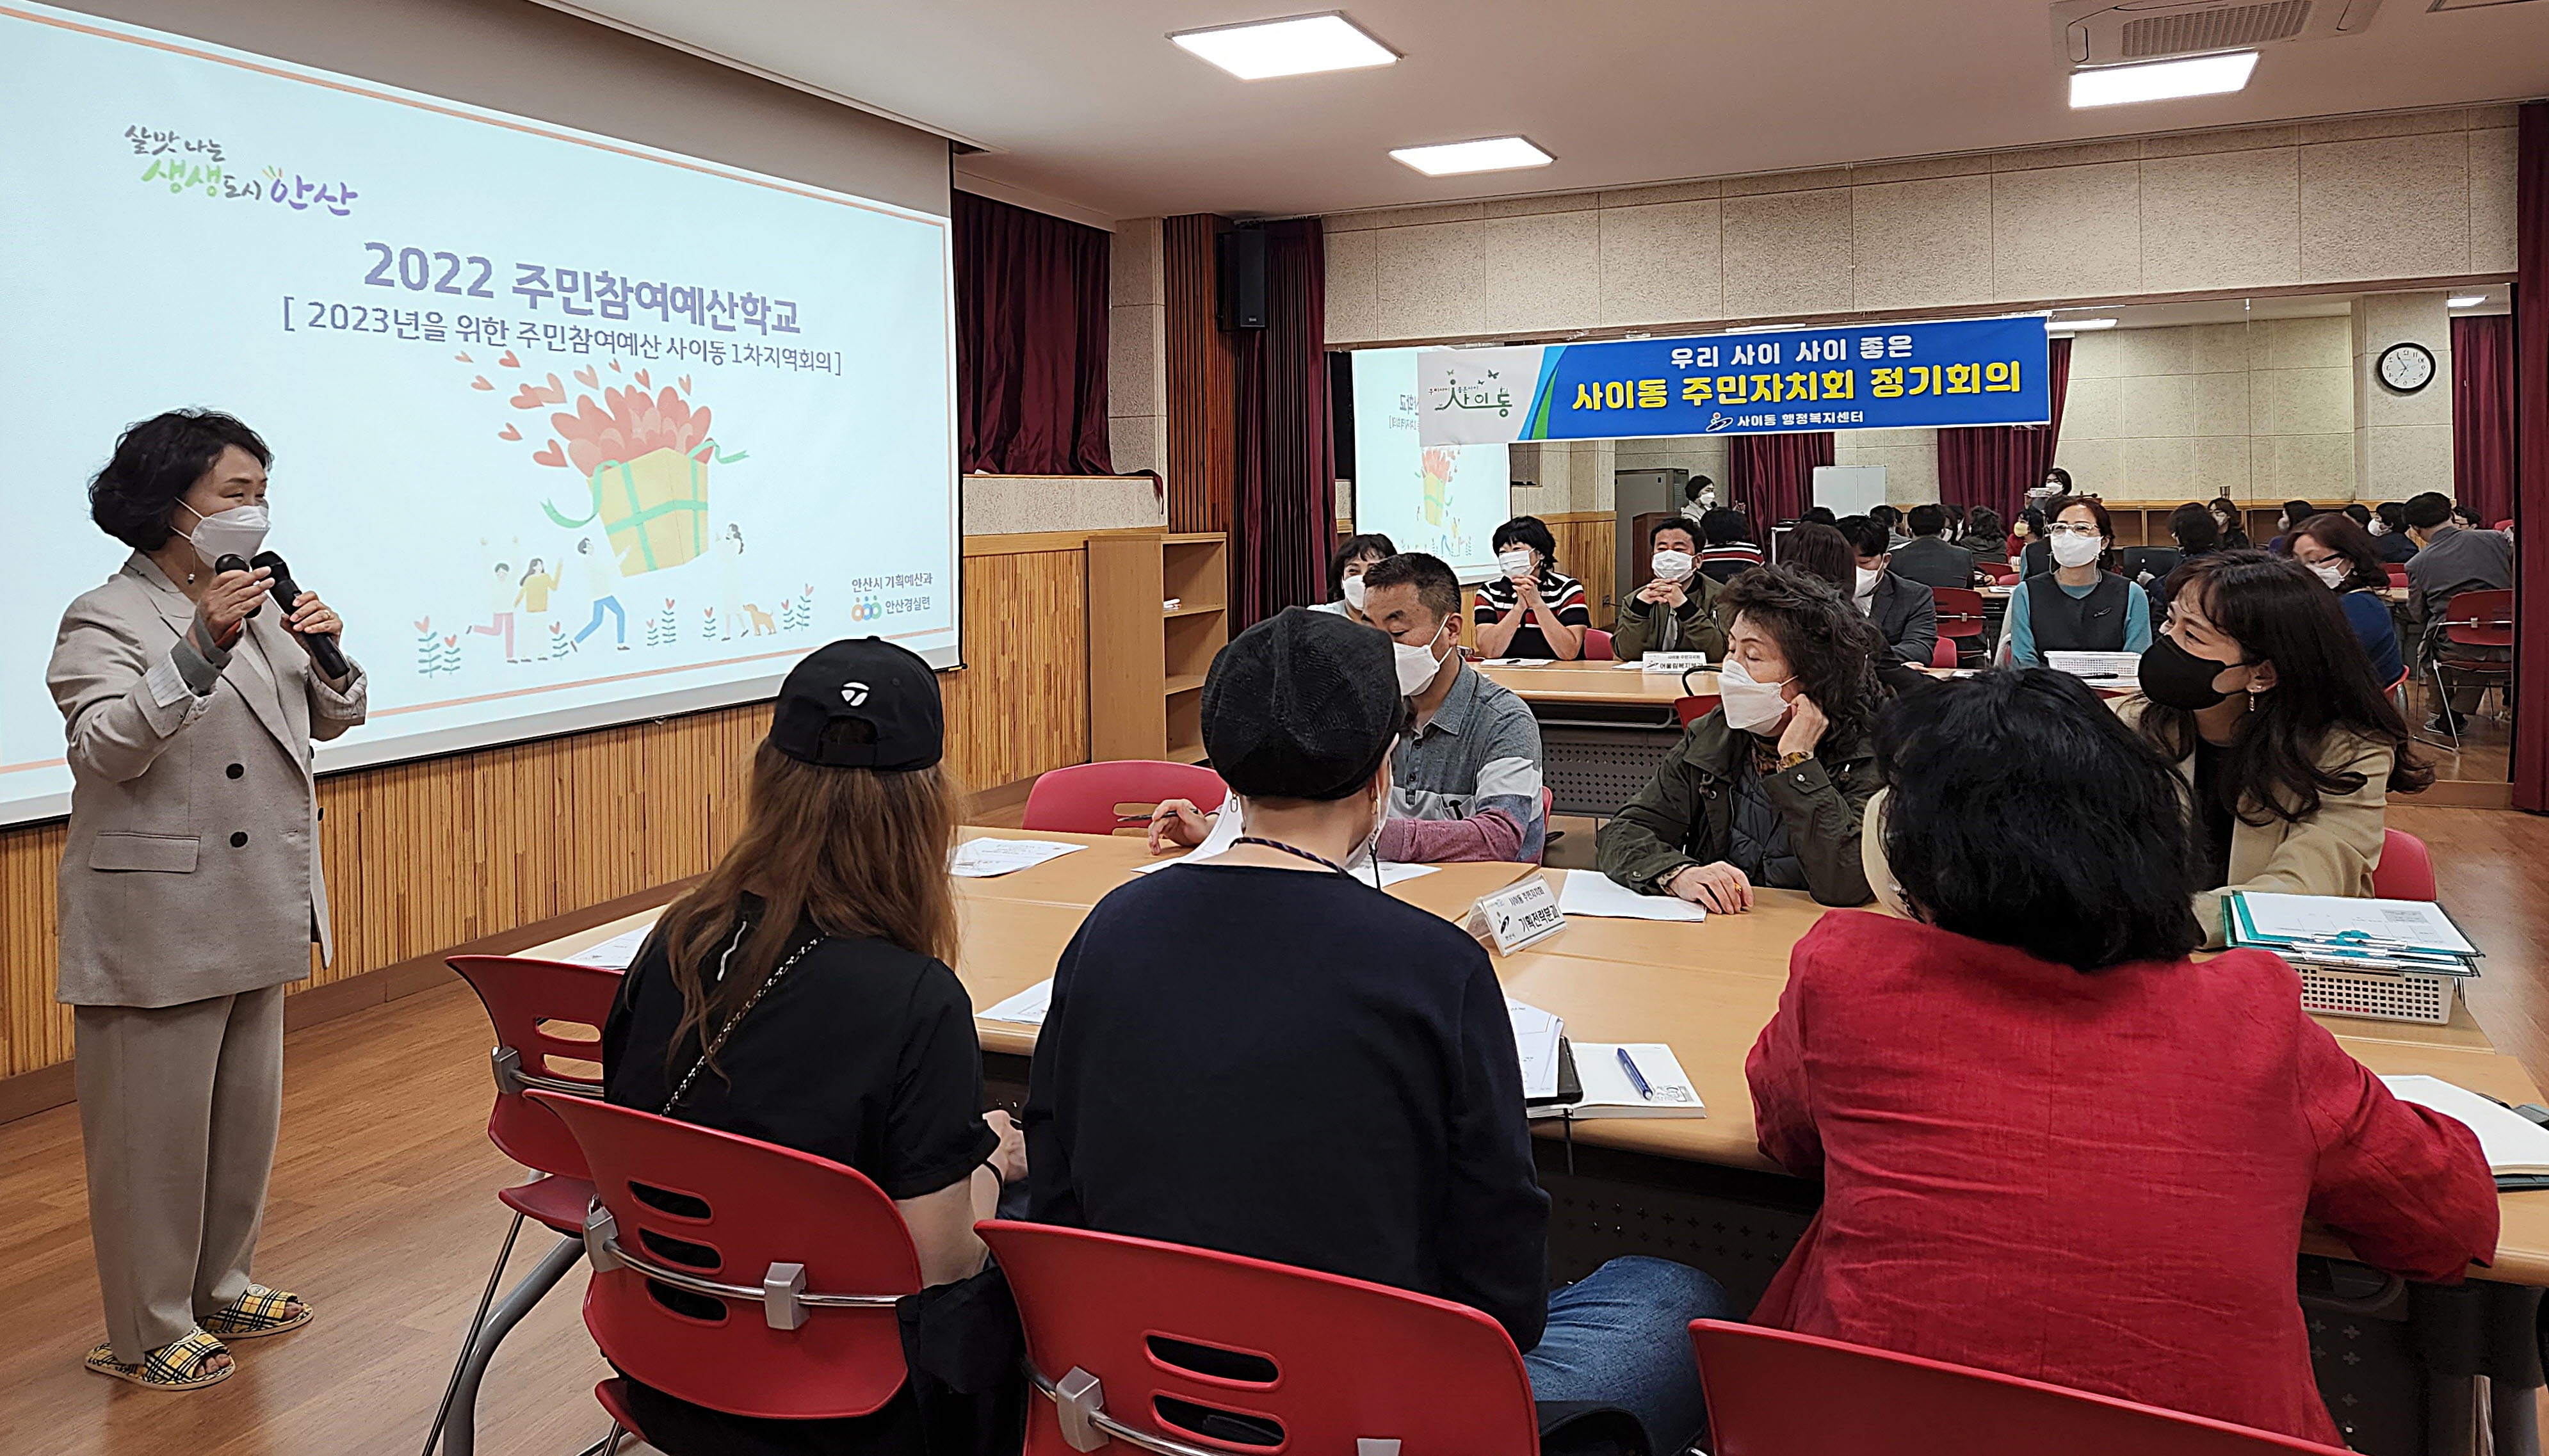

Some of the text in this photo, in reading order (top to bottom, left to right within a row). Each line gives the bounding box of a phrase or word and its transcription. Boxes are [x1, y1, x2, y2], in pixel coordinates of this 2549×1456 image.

[270, 174, 359, 216] 안산
[364, 241, 800, 336] 2022 주민참여예산학교
[307, 301, 448, 342] 2023년을
[455, 314, 510, 346] 위한
[516, 321, 661, 359] 주민참여예산
[666, 337, 727, 366] 사이동
[1671, 336, 1913, 369] 우리 사이 사이 좋은
[1572, 360, 2021, 410] 사이동 주민자치회 정기회의
[1737, 410, 1864, 427] 사이동 행정복지센터
[852, 572, 933, 592] 안산시 기획예산과
[886, 596, 930, 614] 안산경실련
[1518, 903, 1560, 932] 기획전략분과
